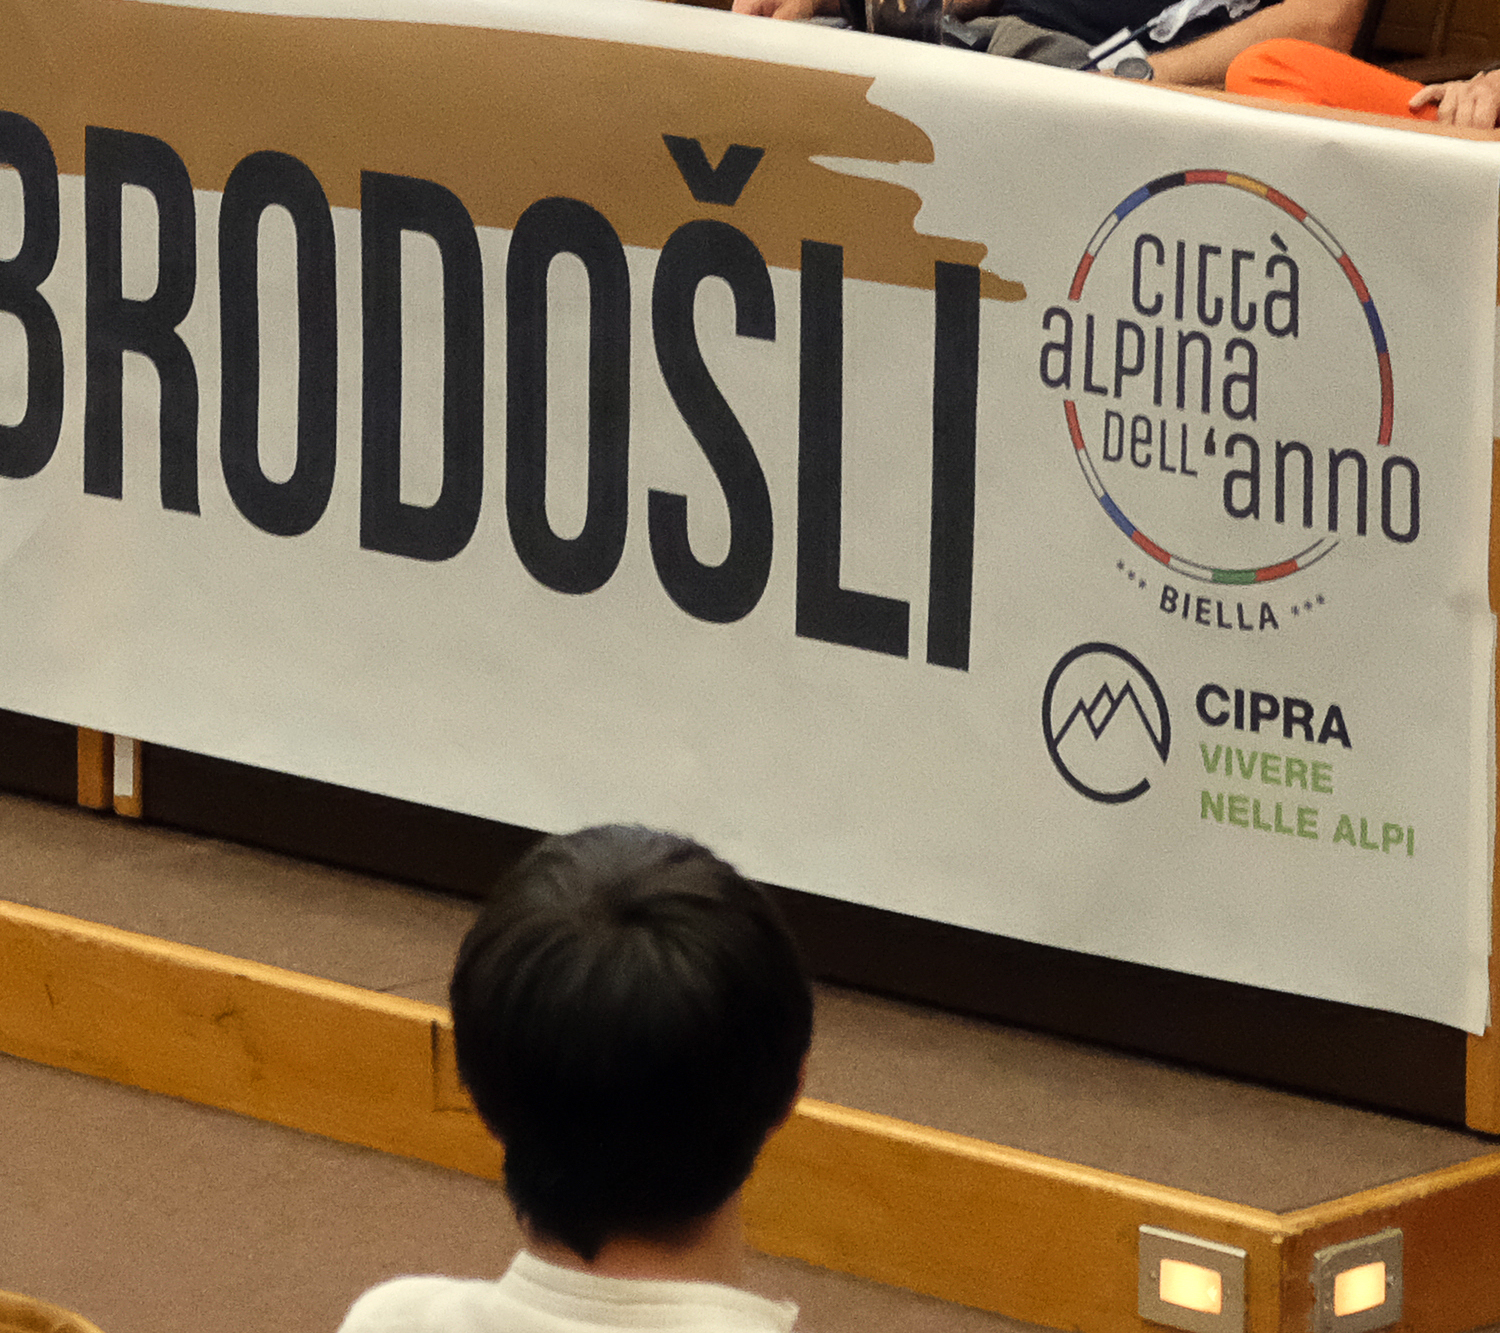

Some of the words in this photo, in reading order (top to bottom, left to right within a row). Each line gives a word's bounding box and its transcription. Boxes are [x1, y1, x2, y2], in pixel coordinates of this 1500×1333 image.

[1160, 584, 1280, 632] BIELLA
[1195, 682, 1353, 750] CIPRA
[1199, 742, 1335, 796] VIVERE
[1200, 789, 1320, 841] NELLE
[1332, 812, 1415, 859] ALPI
